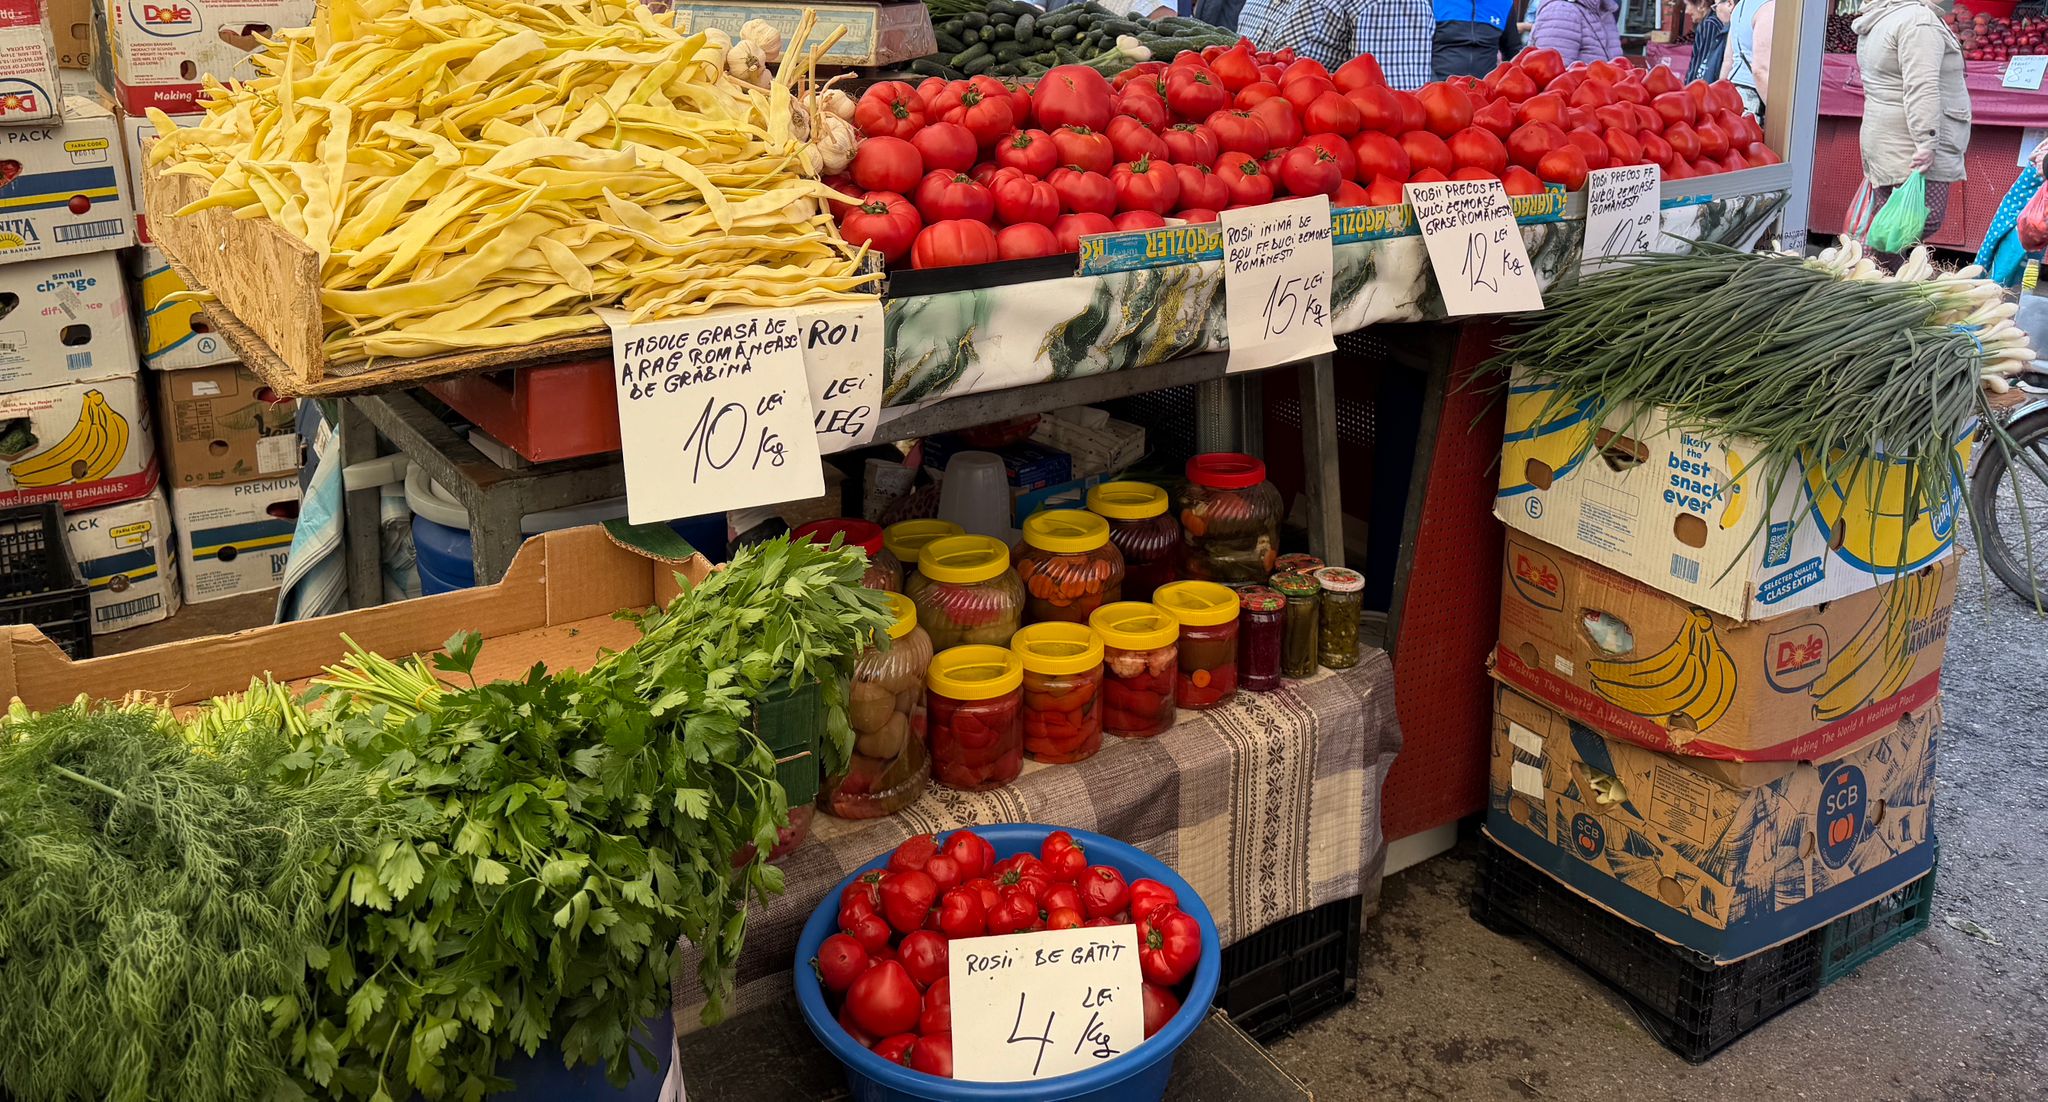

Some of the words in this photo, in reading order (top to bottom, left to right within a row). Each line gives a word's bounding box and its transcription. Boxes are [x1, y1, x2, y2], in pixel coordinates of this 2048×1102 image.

[144, 4, 192, 22] Dole
[154, 90, 192, 102] Making
[8, 129, 52, 144] PACK
[1445, 182, 1487, 198] PRECOS
[52, 268, 82, 280] small
[1462, 232, 1498, 293] 12
[1263, 275, 1302, 340] 15
[624, 333, 690, 359] FASOLE
[683, 396, 748, 484] 10
[1687, 448, 1702, 459] the
[1668, 451, 1711, 478] best
[23, 490, 73, 504] PREMIUM
[76, 484, 124, 498] BANANAS
[234, 480, 299, 496] PREMIUM
[1663, 489, 1712, 514] ever
[1670, 474, 1723, 502] snack
[1764, 573, 1793, 592] SELECTED
[1793, 561, 1819, 578] QUALITY
[1766, 583, 1791, 601] CLASS
[1792, 571, 1818, 589] EXTRA
[1776, 634, 1823, 670] Dole
[1508, 659, 1539, 686] Making
[1544, 679, 1561, 695] The
[1565, 689, 1594, 711] World
[1596, 707, 1603, 718] A
[1608, 711, 1660, 744] Healthier
[1790, 740, 1819, 758] Making
[1822, 732, 1835, 744] The
[1837, 719, 1857, 738] World
[1866, 701, 1898, 723] Healthier
[1899, 693, 1916, 711] Place
[1826, 785, 1858, 815] SCB
[1577, 820, 1600, 839] SCB
[1007, 992, 1055, 1076] 4
